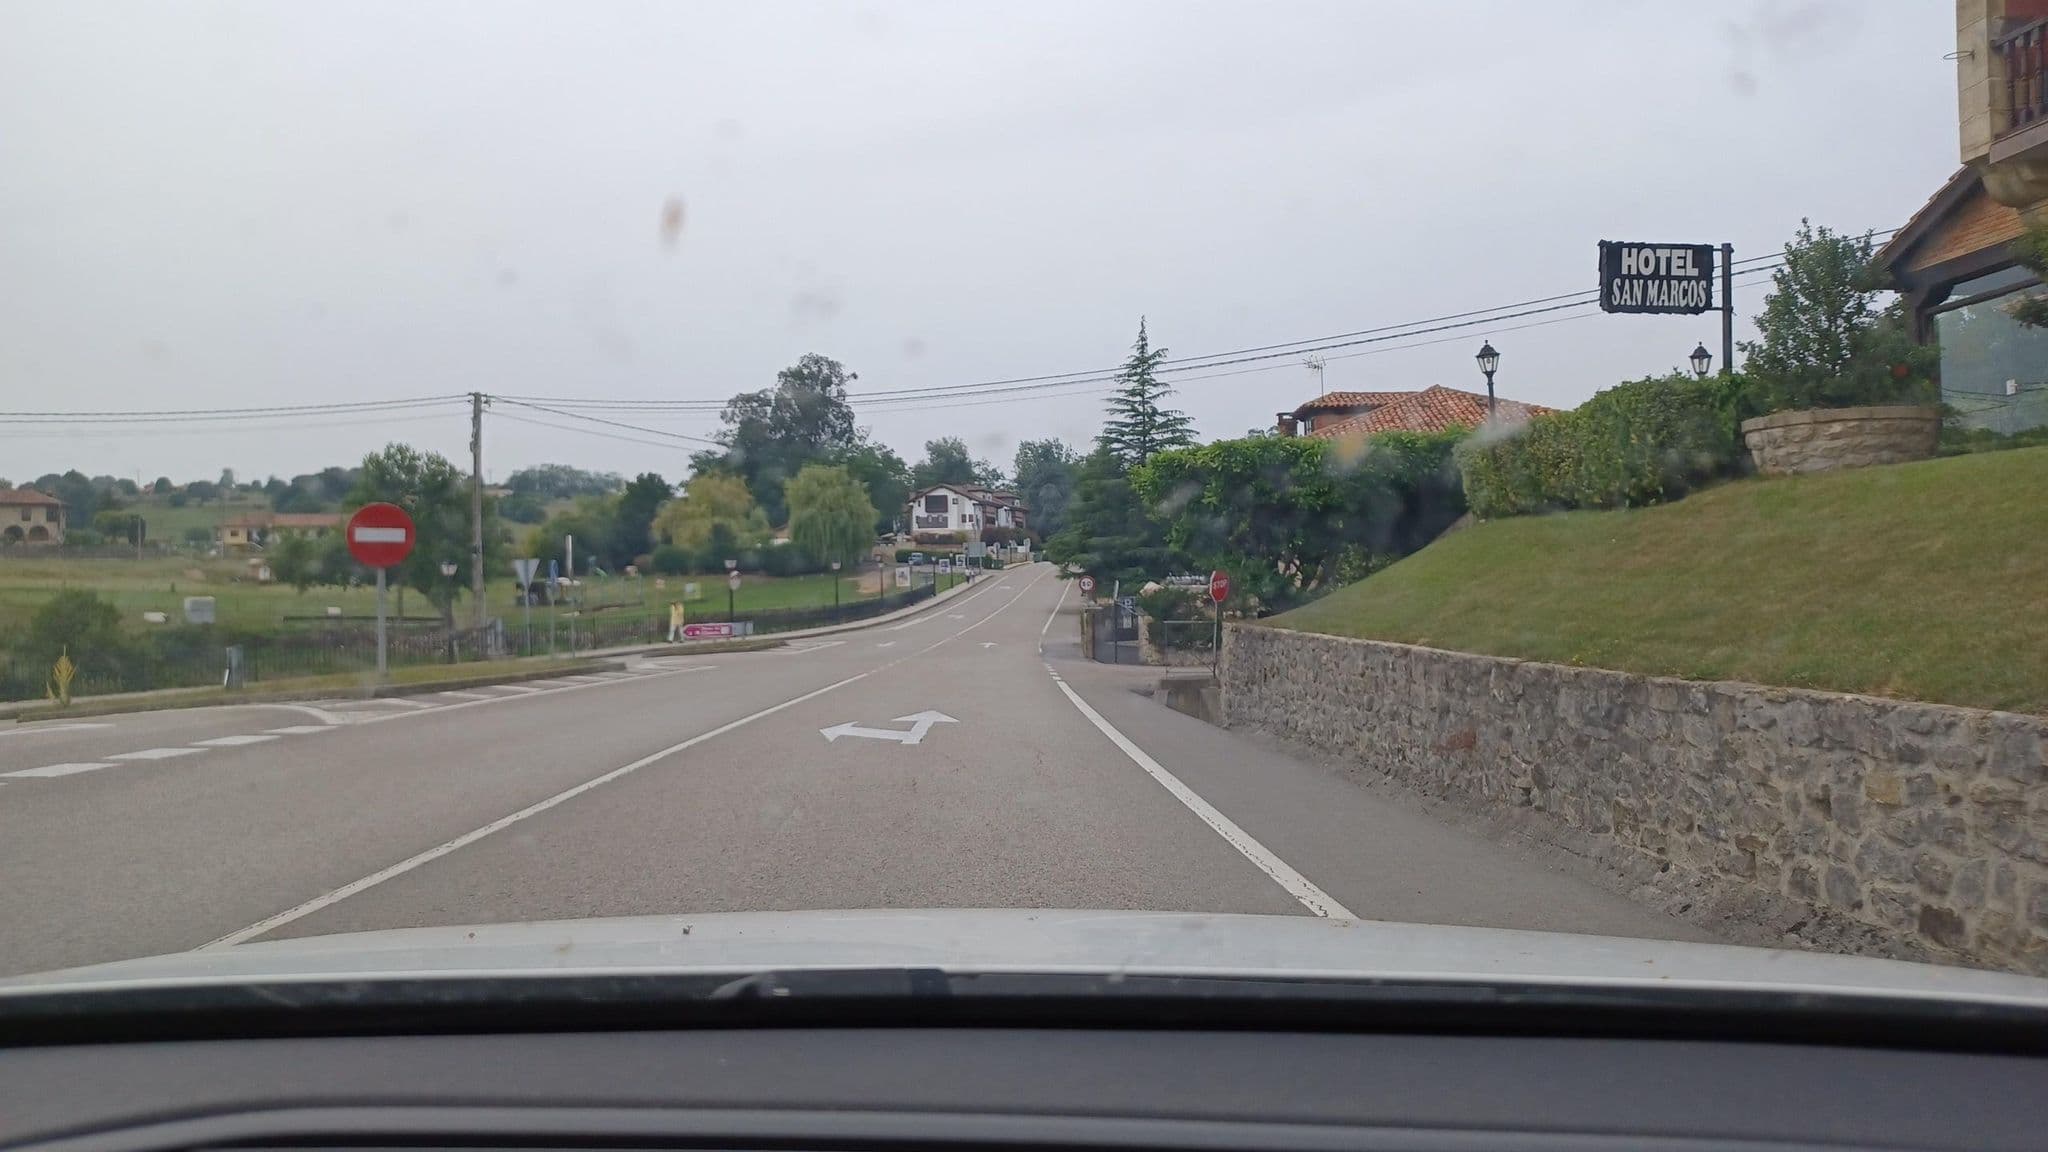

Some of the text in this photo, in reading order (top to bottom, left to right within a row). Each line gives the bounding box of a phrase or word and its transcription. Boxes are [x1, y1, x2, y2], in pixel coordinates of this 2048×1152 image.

[1621, 247, 1699, 276] HOTEL
[1611, 278, 1707, 308] SAN MARCOS
[1213, 579, 1228, 590] STOP
